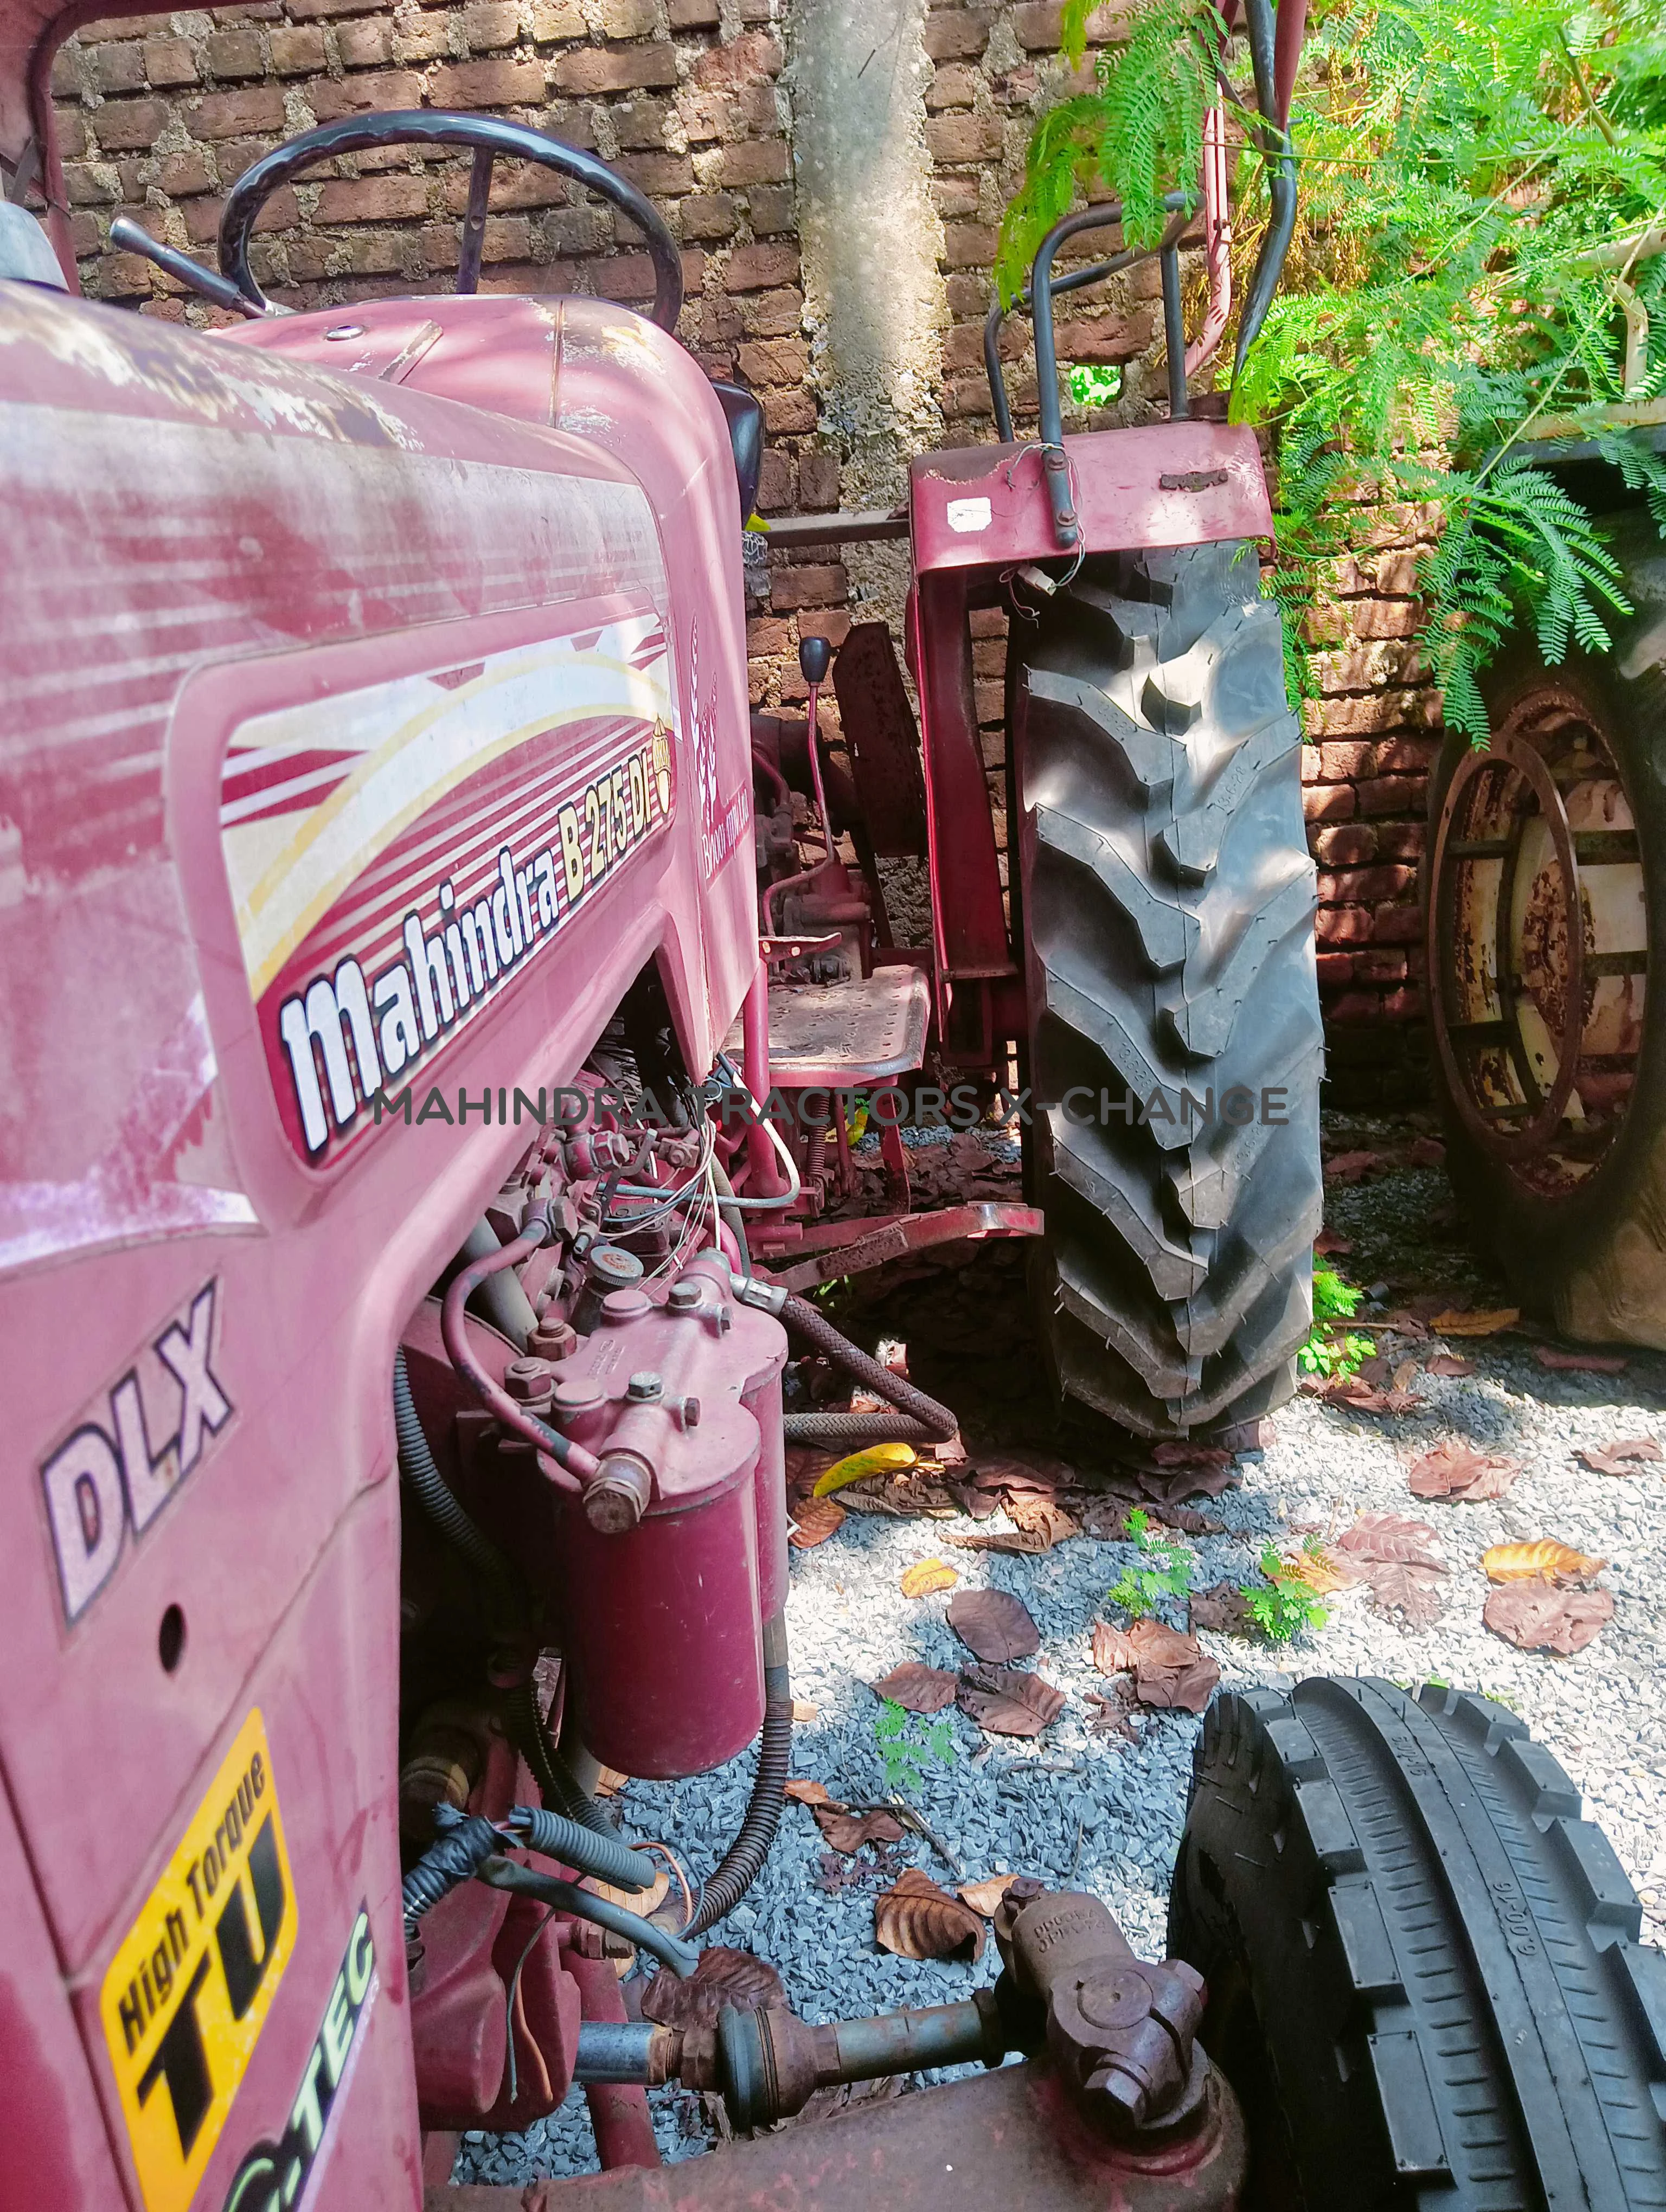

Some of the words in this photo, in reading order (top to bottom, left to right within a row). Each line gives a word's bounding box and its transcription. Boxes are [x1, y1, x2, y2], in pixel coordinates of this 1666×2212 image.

[280, 846, 561, 1156] Mahindra
[558, 801, 585, 904] B
[585, 764, 629, 882] 275
[628, 748, 653, 837] DI
[39, 1271, 234, 1631] DLX
[117, 1906, 189, 2058] High
[185, 1751, 266, 1920] Torque
[1492, 1881, 1538, 1957] 6.00-16
